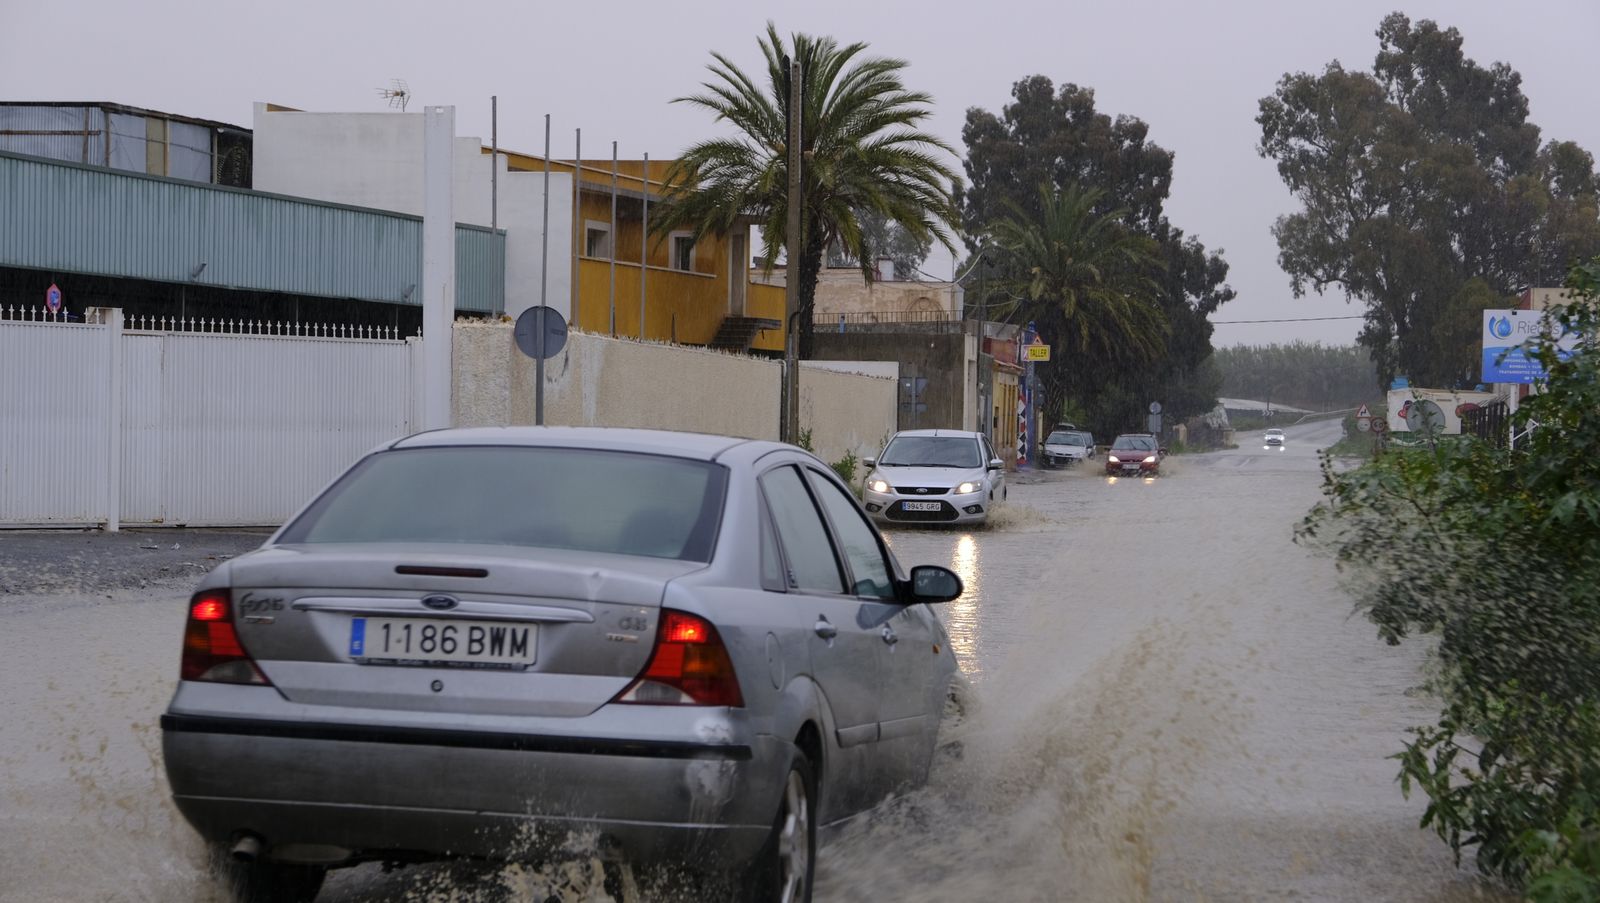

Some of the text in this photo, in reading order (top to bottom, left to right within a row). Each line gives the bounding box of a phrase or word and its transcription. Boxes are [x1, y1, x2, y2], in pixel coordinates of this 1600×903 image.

[1517, 320, 1560, 335] Ries
[1030, 348, 1047, 358] TALLER
[907, 502, 924, 510] 9945
[382, 623, 529, 657] 1186 BWM
